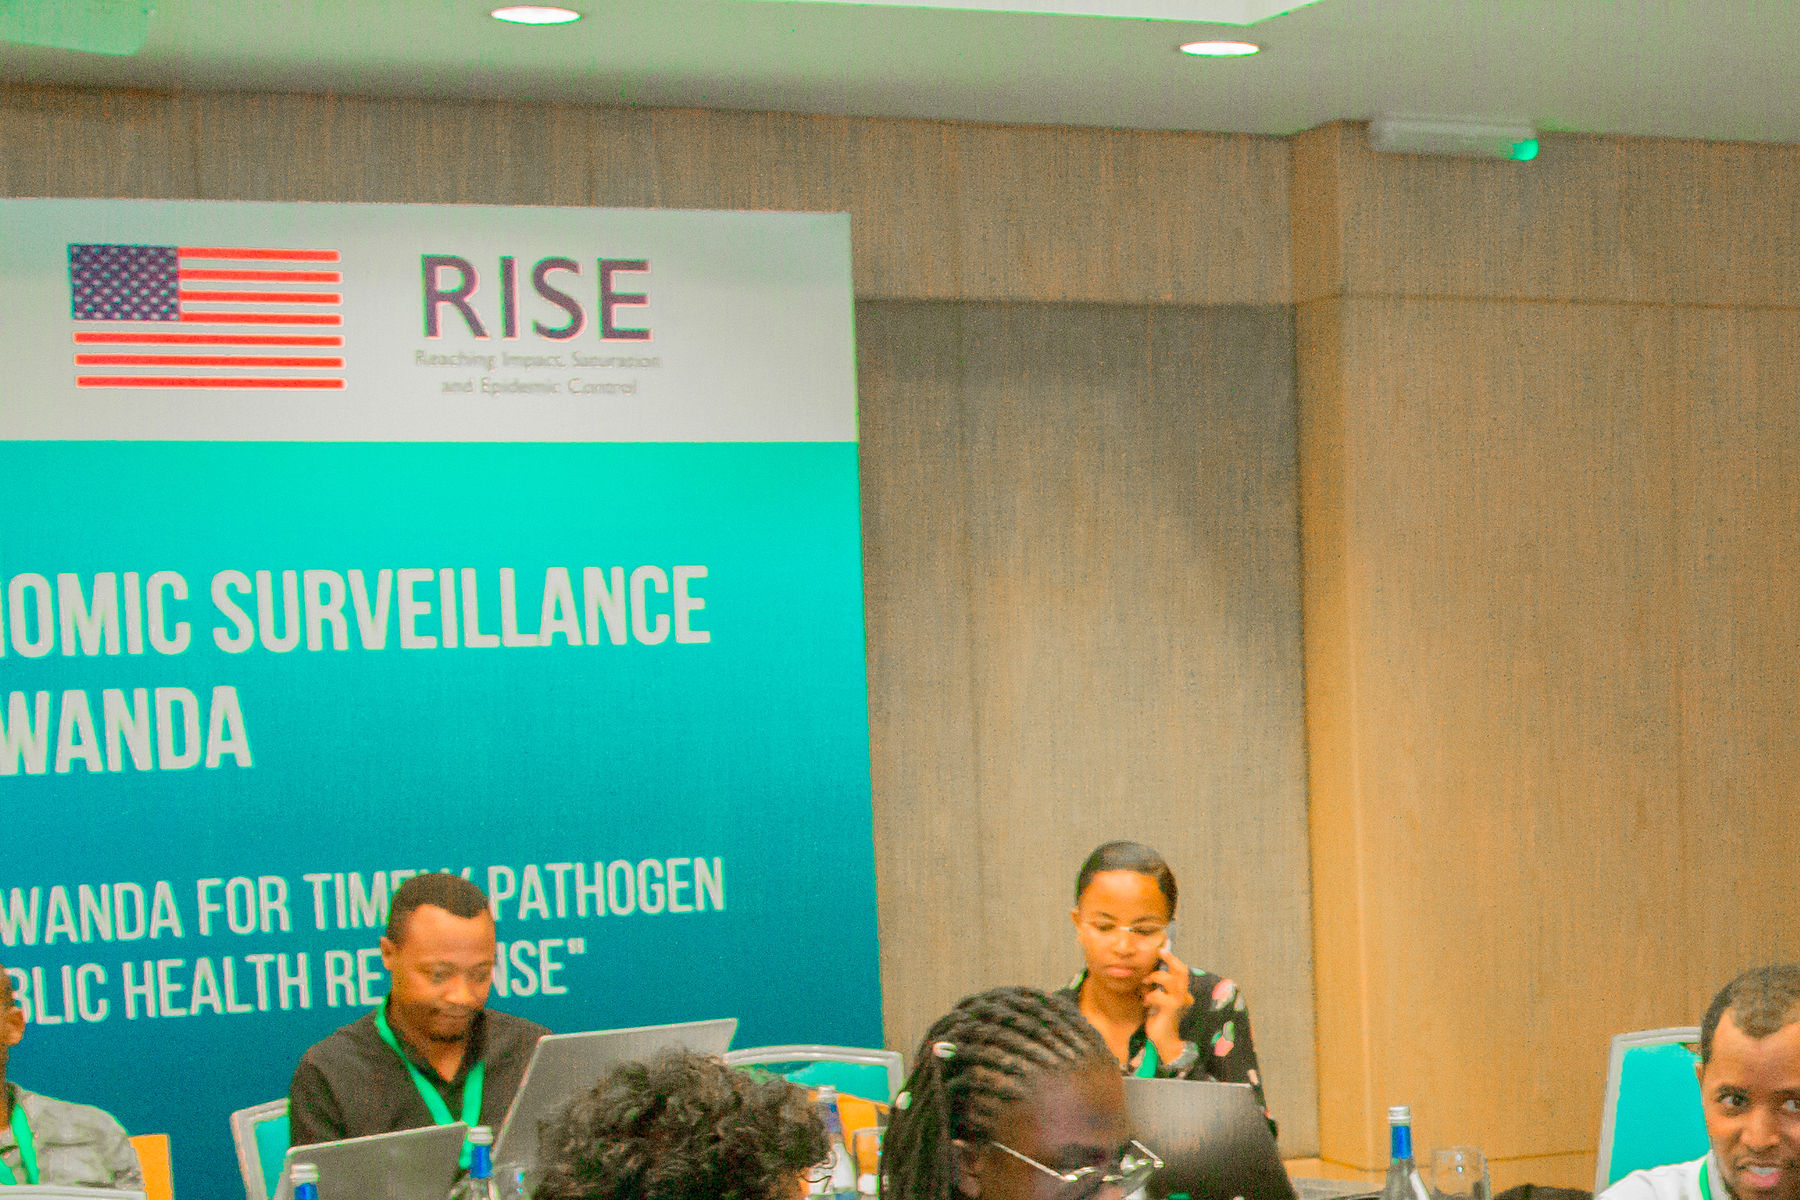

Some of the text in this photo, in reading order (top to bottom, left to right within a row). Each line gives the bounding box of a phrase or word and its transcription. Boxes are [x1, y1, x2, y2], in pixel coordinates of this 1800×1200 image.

[421, 254, 653, 342] RISE
[441, 377, 638, 398] and Epidemic Control
[0, 564, 711, 659] OMIC SURVEILLANCE
[0, 686, 252, 776] WANDA
[0, 856, 726, 947] WANDA FOR TIM PATHOGEN
[122, 951, 310, 1021] HEALTH
